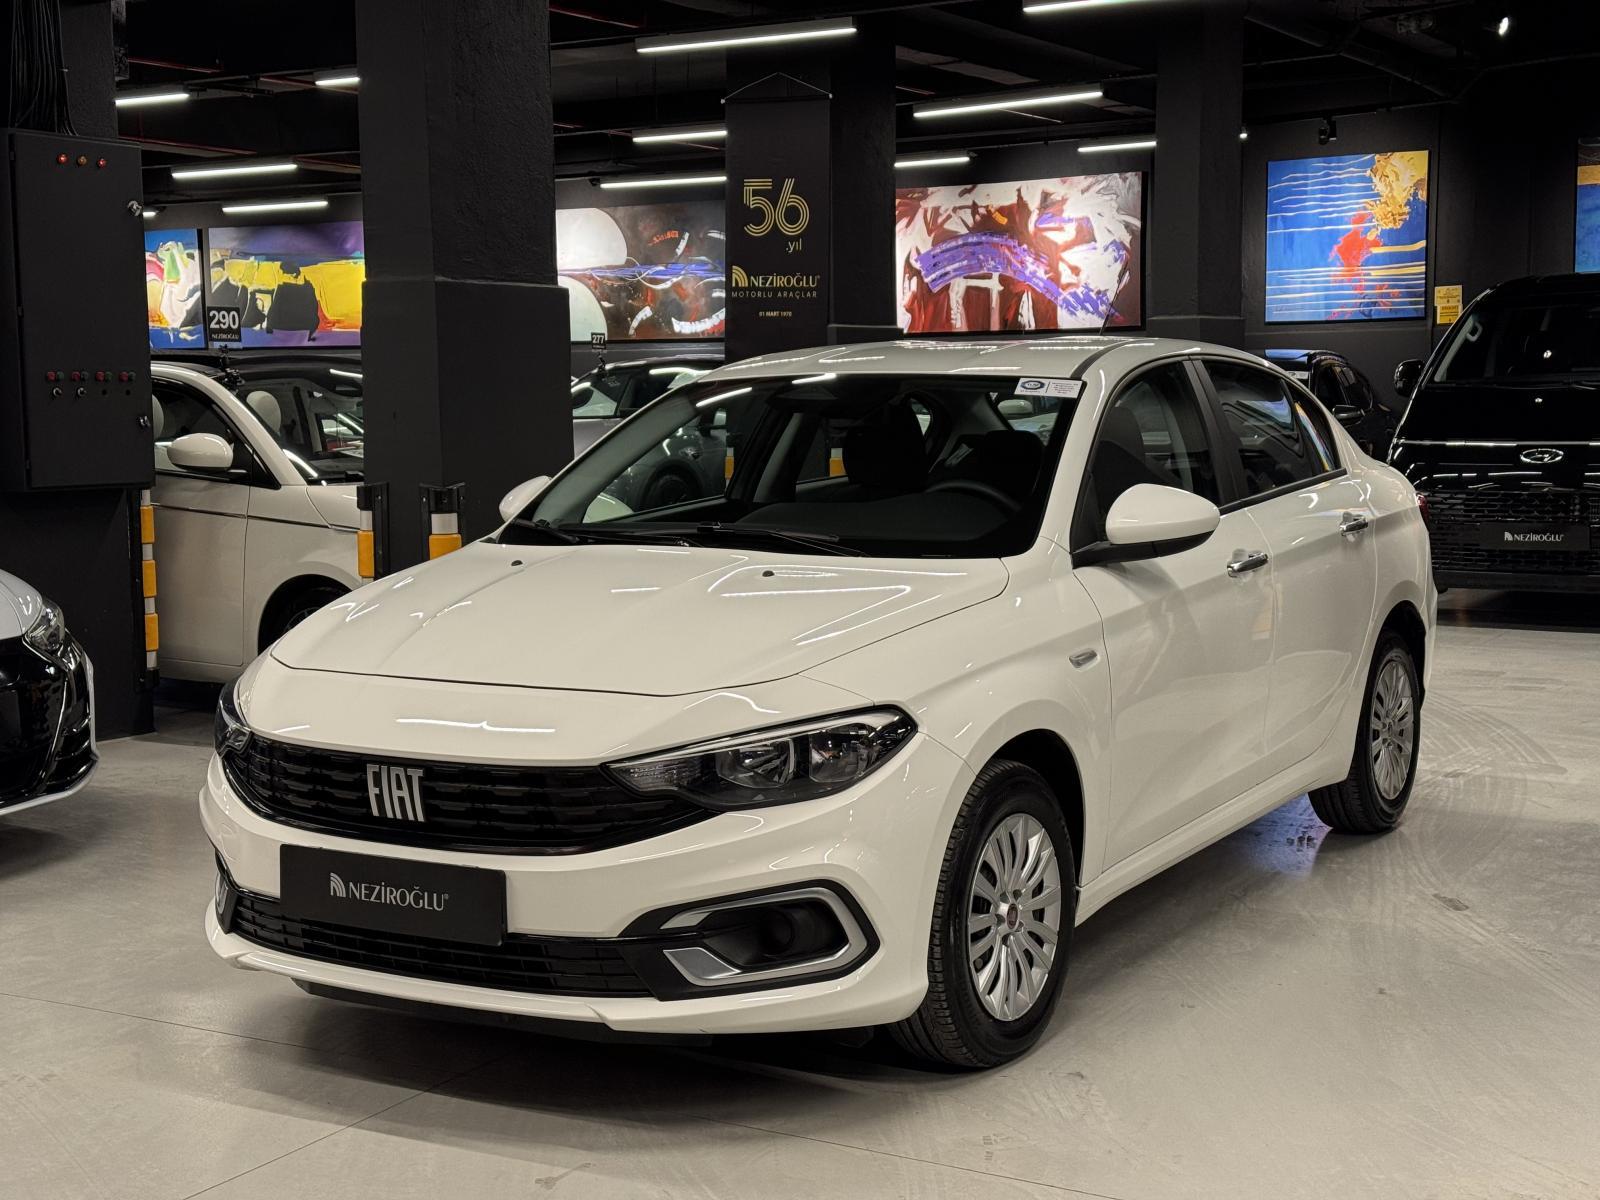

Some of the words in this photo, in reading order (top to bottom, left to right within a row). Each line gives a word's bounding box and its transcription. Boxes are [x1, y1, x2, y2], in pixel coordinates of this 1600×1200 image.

[743, 178, 810, 237] 56
[731, 290, 773, 298] MOTORLU
[777, 290, 817, 300] ARAÇLAR
[209, 310, 240, 329] 290
[592, 334, 605, 344] 277
[366, 763, 425, 822] FIAT
